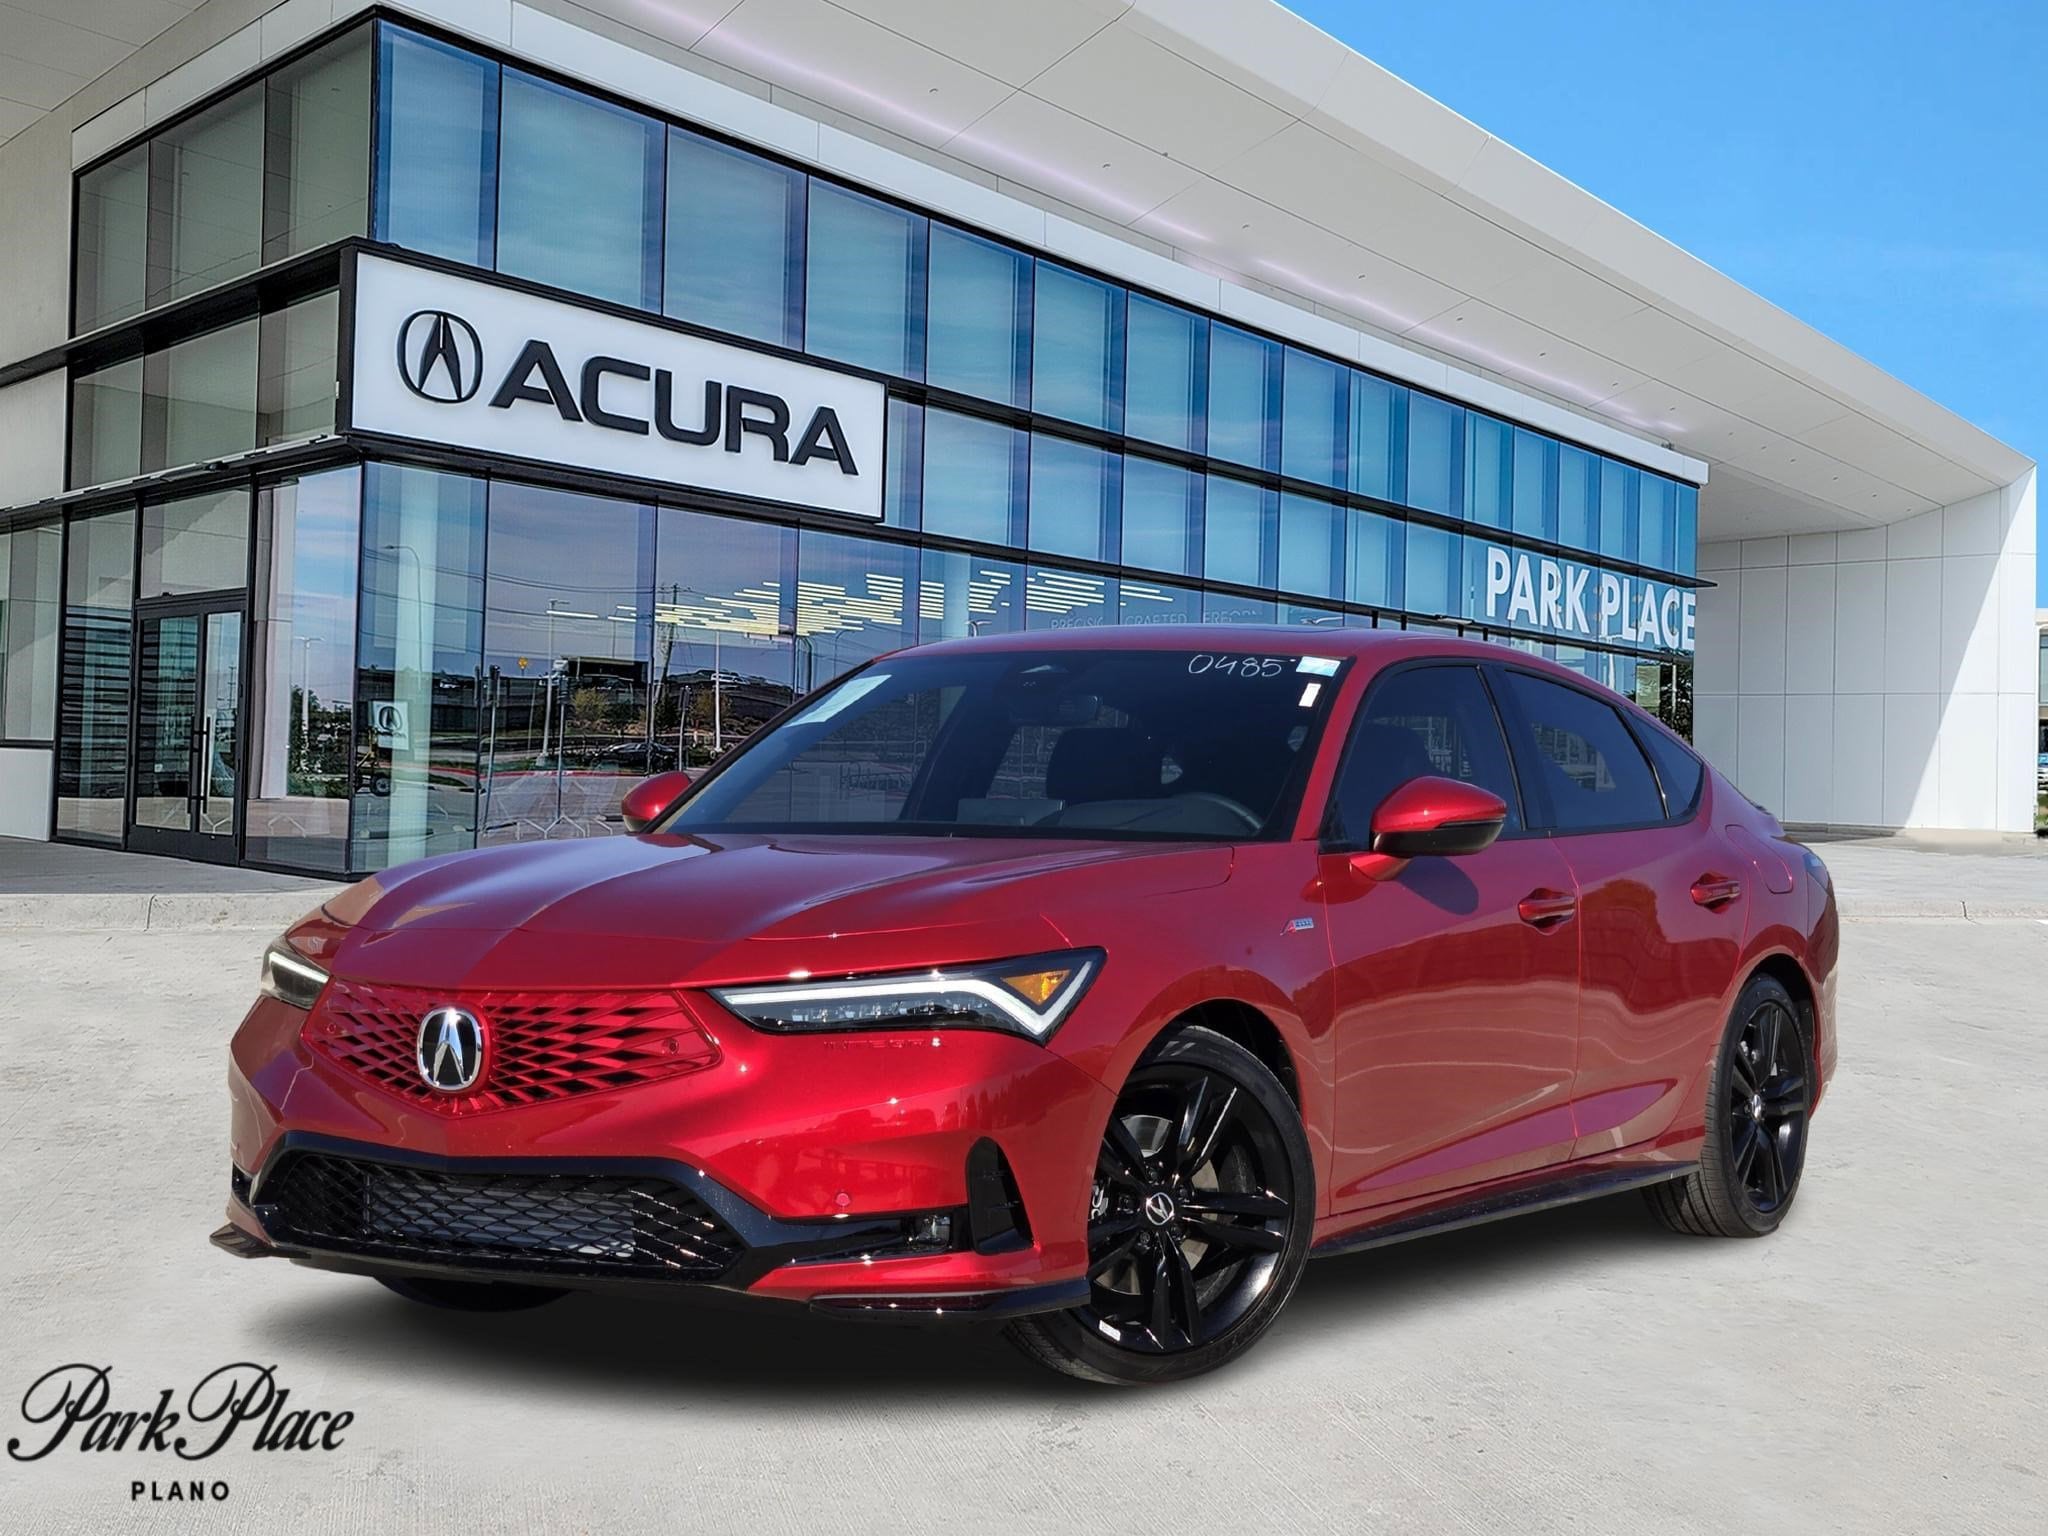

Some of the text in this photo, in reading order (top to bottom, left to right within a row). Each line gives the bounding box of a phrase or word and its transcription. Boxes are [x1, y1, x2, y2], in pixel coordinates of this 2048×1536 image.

[489, 339, 859, 476] ACURA
[1487, 547, 1695, 650] PARK PLACE
